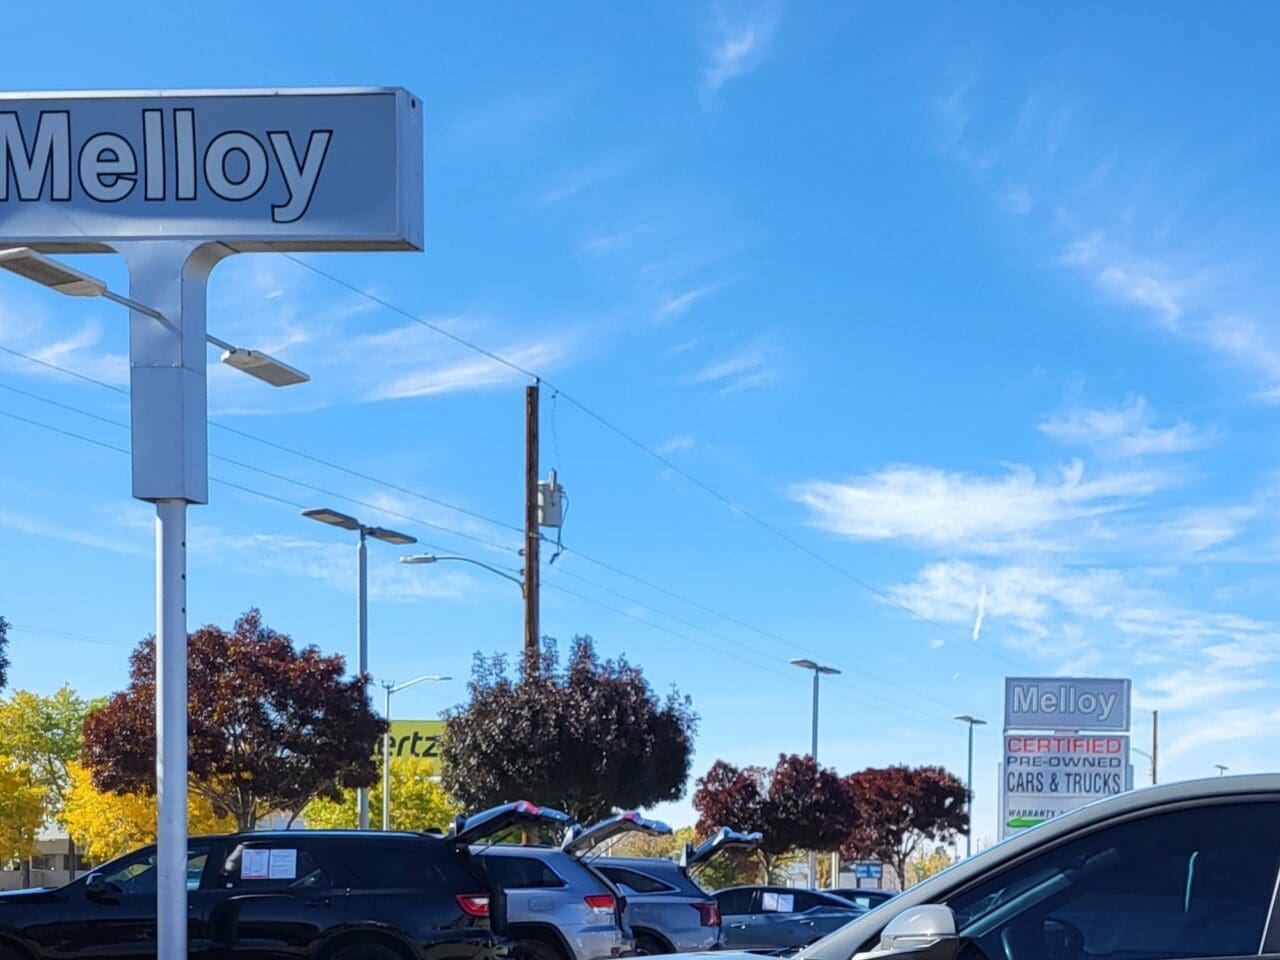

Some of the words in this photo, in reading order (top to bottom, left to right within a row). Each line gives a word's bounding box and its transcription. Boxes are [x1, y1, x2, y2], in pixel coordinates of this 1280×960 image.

[0, 108, 334, 223] Melloy
[1012, 683, 1117, 721] Melloy
[1007, 737, 1122, 754] CERTIFIED
[1006, 756, 1122, 768] PRE-OWNED
[1006, 771, 1044, 793] CARS
[1049, 773, 1059, 793] &
[1065, 772, 1121, 794] TRUCKS
[1008, 809, 1056, 818] WARRANTY
